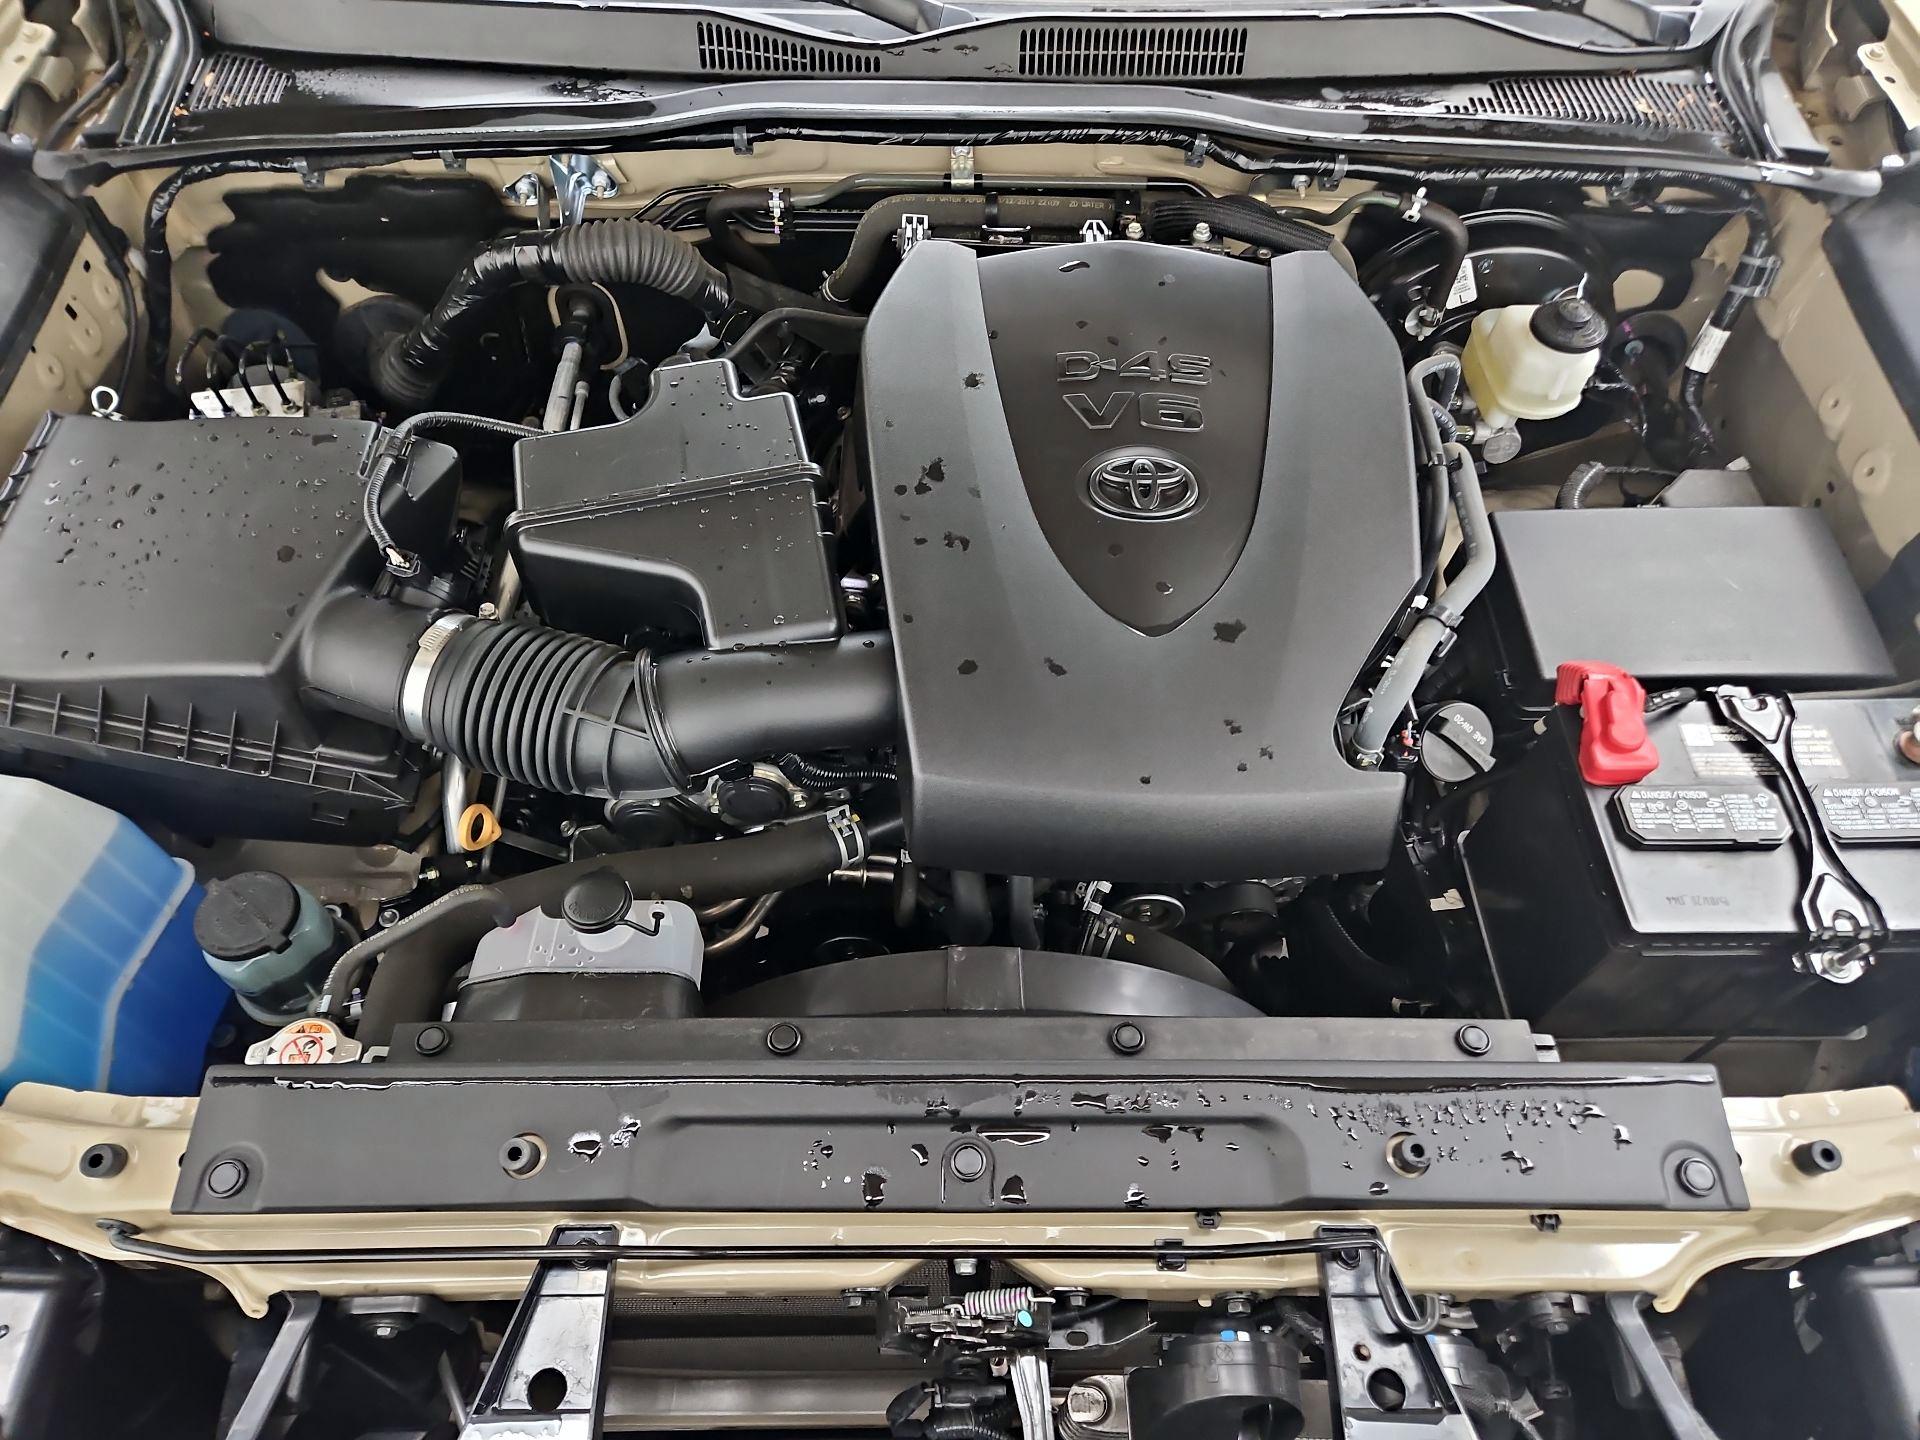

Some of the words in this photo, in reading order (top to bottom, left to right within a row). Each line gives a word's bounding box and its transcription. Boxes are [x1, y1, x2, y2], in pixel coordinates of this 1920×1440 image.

[1056, 350, 1213, 386] D-4S
[1062, 391, 1204, 433] V6
[1453, 713, 1474, 734] 0W-20
[1472, 730, 1487, 746] SAE
[1640, 790, 1672, 800] DANGER
[1678, 790, 1709, 800] POISON
[1832, 788, 1863, 798] DANGER
[1870, 788, 1900, 797] POISON
